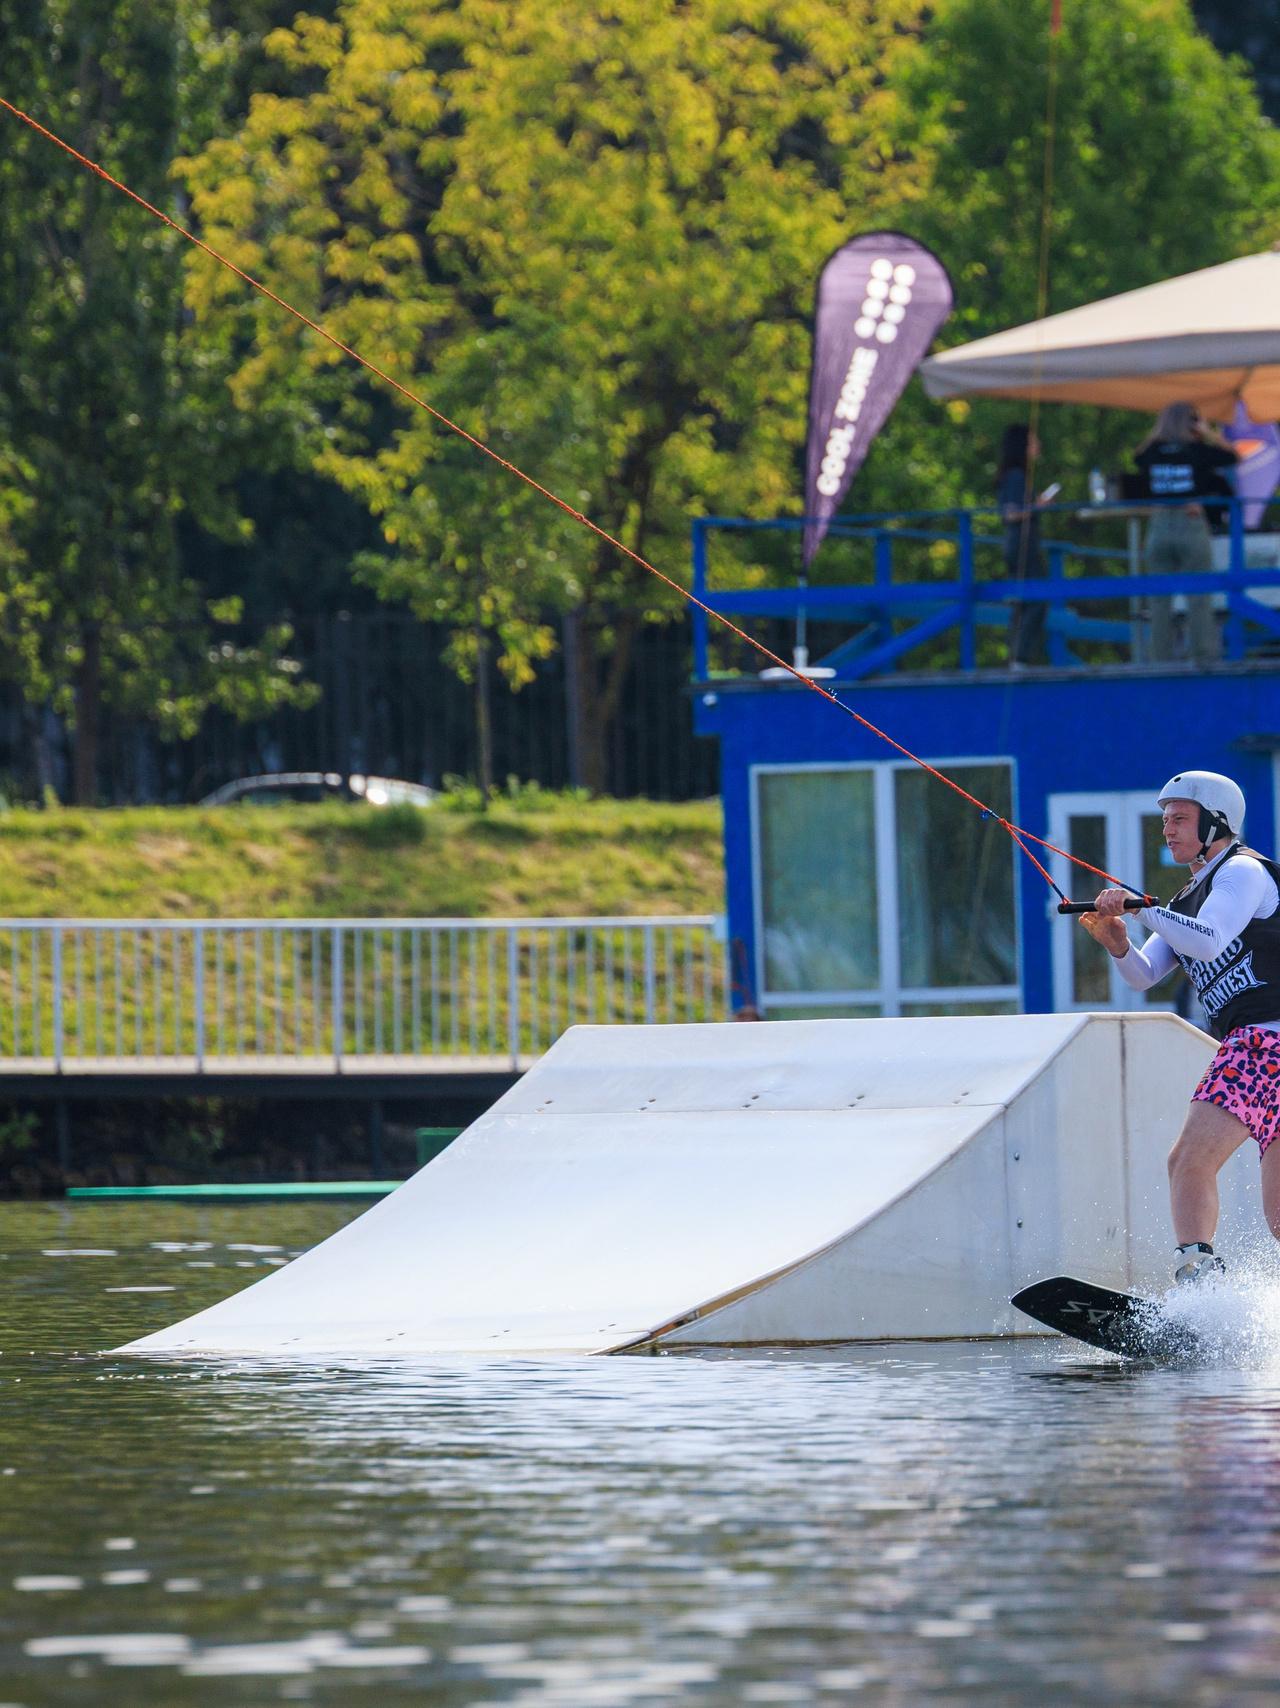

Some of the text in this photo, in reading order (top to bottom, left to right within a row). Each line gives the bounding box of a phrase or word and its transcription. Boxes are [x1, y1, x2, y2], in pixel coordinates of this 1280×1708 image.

[816, 347, 878, 496] COOL ZONE
[1202, 955, 1262, 1017] CONTEST
